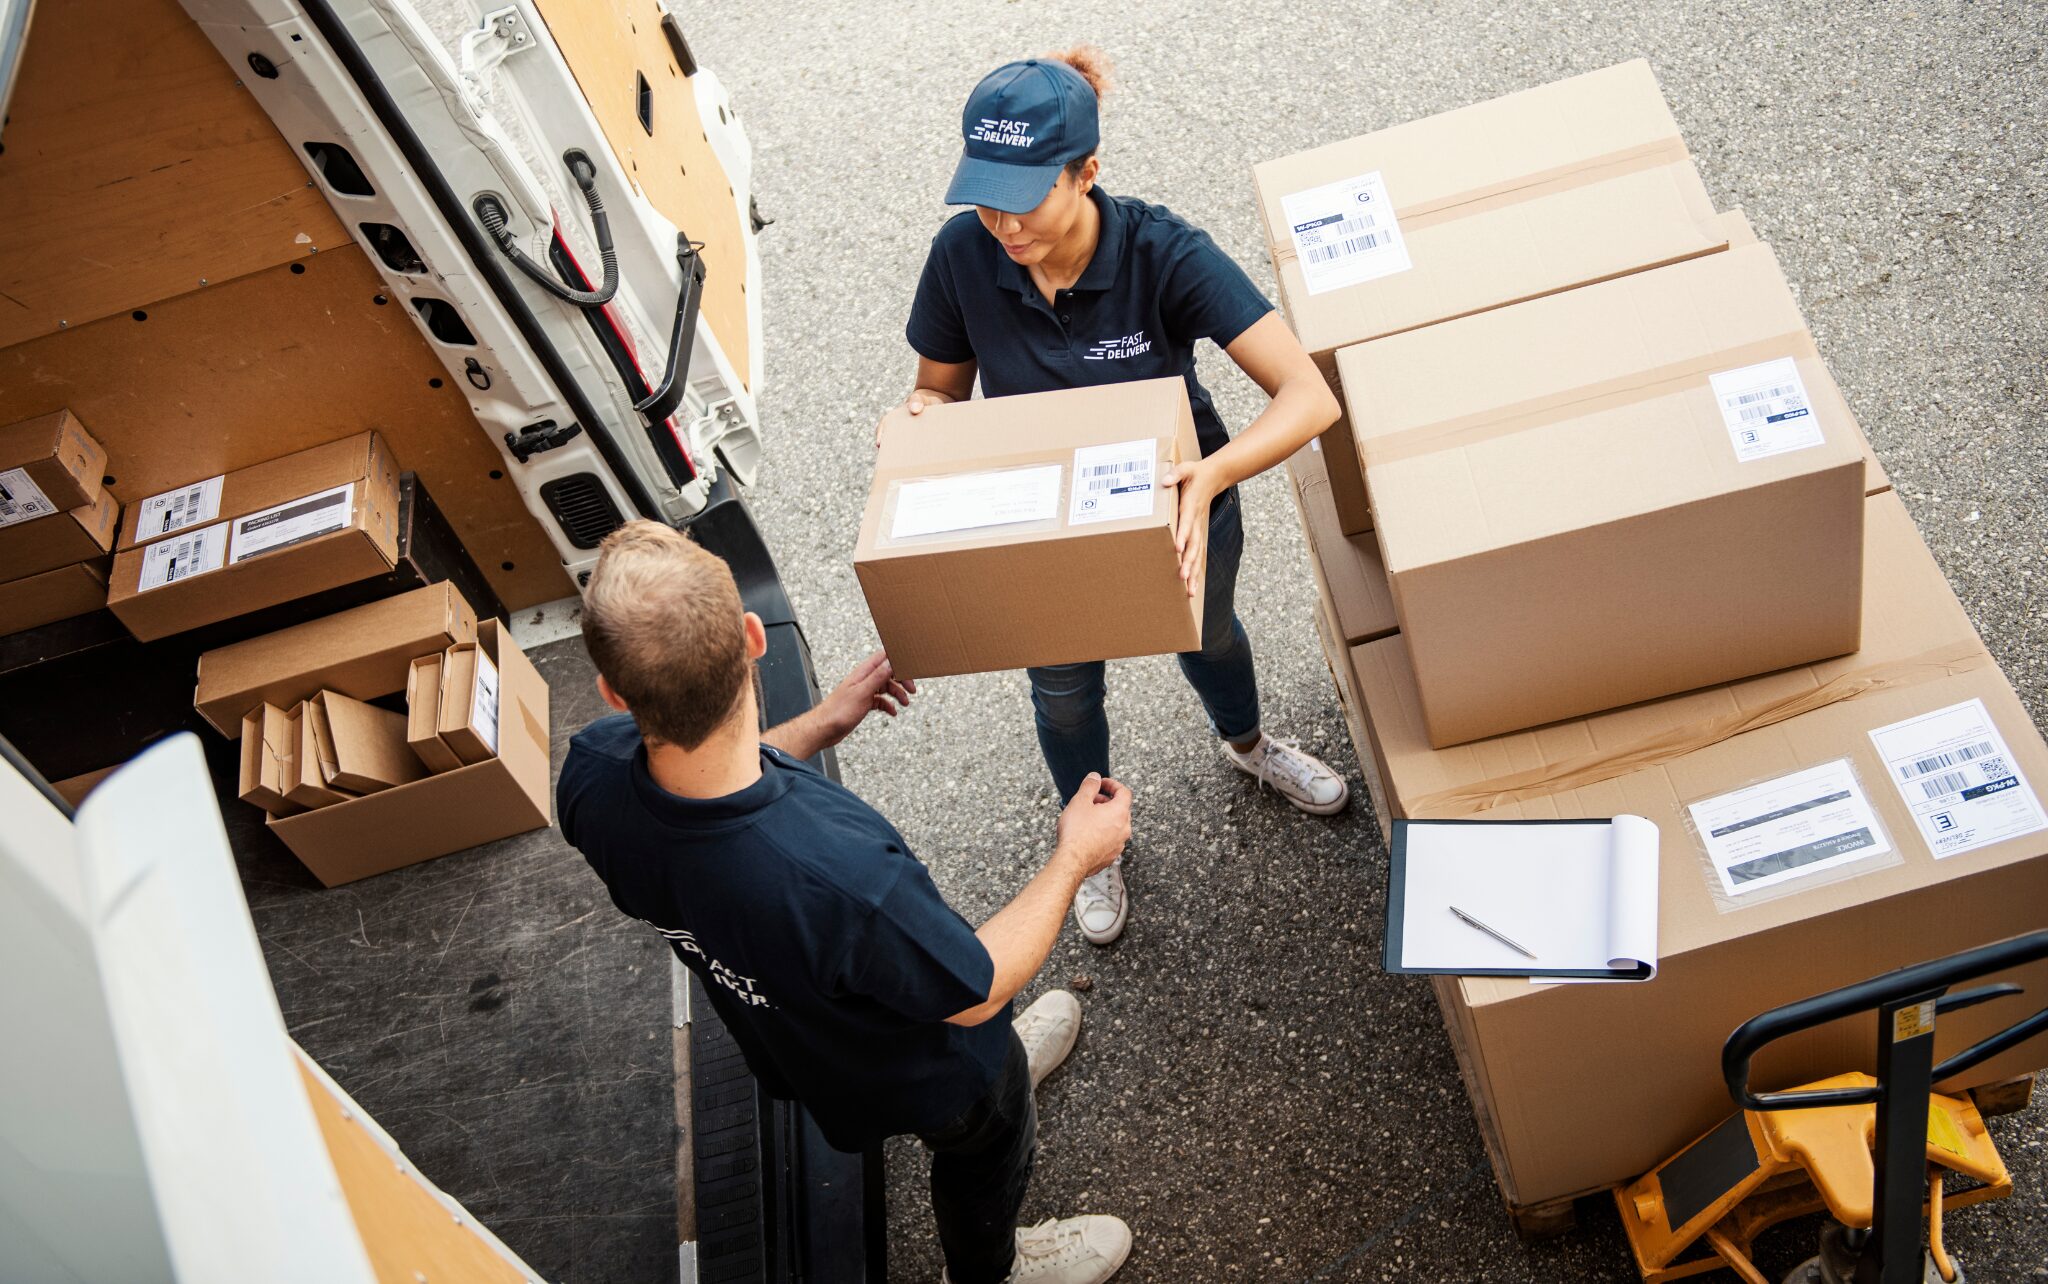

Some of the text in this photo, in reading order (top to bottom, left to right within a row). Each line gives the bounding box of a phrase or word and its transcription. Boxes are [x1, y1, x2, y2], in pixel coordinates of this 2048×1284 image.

[998, 119, 1030, 134] FAST
[983, 131, 1034, 148] DELIVERY
[1357, 192, 1370, 202] G
[1121, 331, 1144, 348] FAST
[1107, 340, 1152, 360] DELIVERY
[247, 515, 270, 527] PACKING
[1985, 778, 2017, 793] W-PKG
[1936, 815, 1952, 829] E
[1837, 840, 1866, 852] INVOICE
[1935, 833, 1963, 845] DELIVERY
